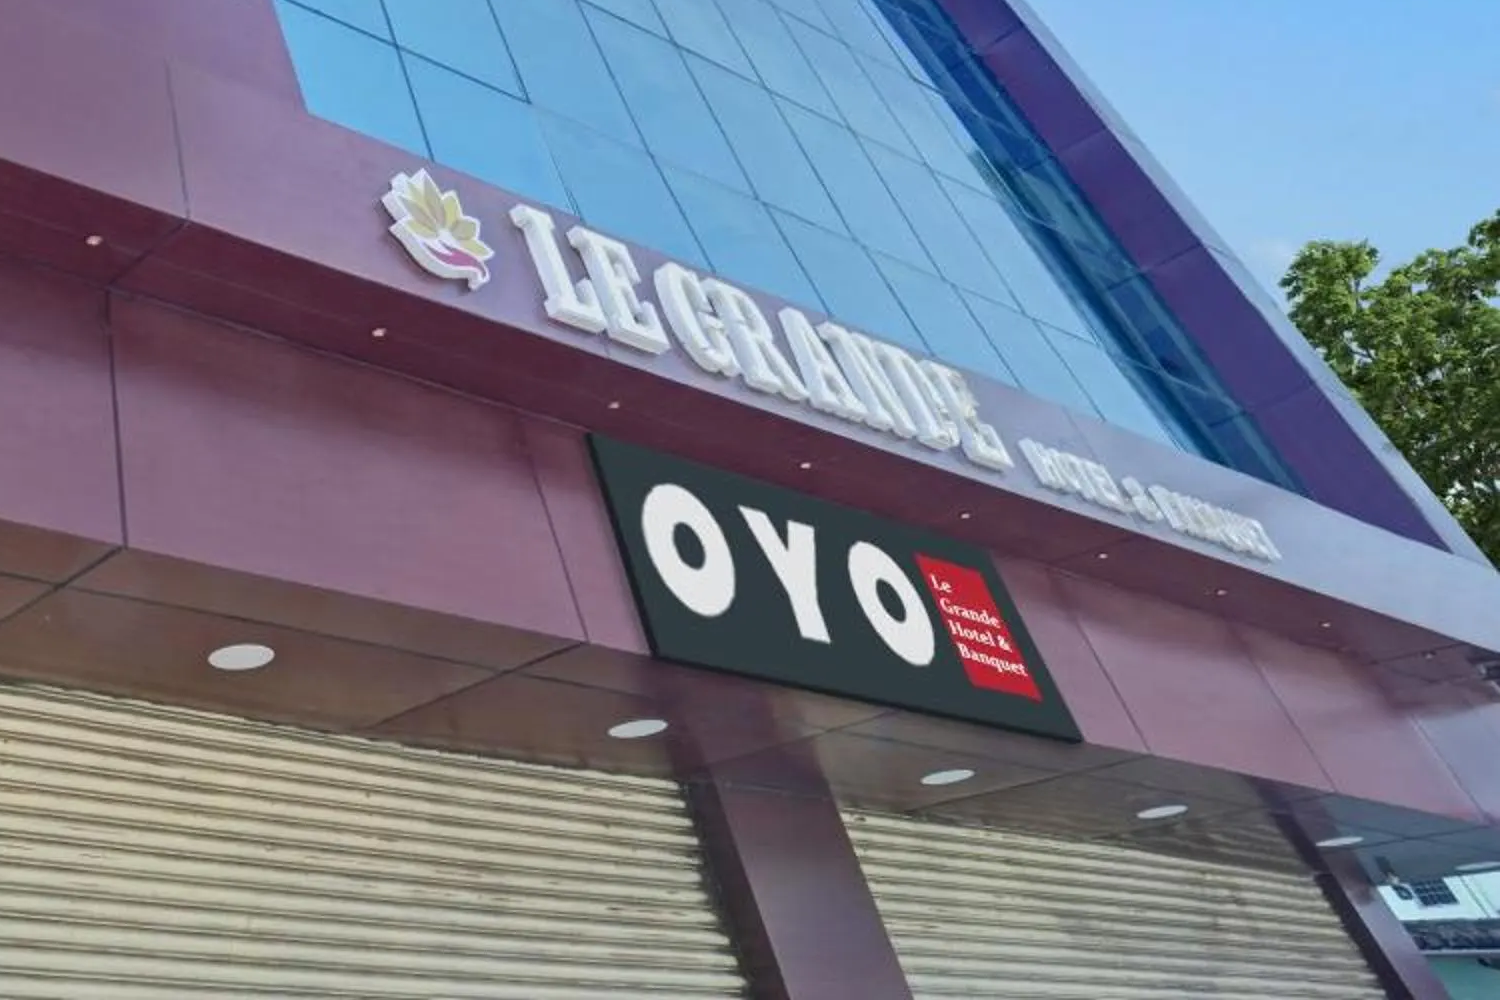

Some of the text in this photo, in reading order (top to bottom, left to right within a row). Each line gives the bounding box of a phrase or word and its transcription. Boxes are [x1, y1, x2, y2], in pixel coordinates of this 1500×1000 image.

[509, 203, 1014, 473] LE GRANDE
[641, 483, 935, 666] OYO
[929, 573, 952, 593] Le
[939, 597, 1001, 629] Grande
[948, 619, 1013, 653] Hotel &
[956, 641, 1028, 677] Banquet
